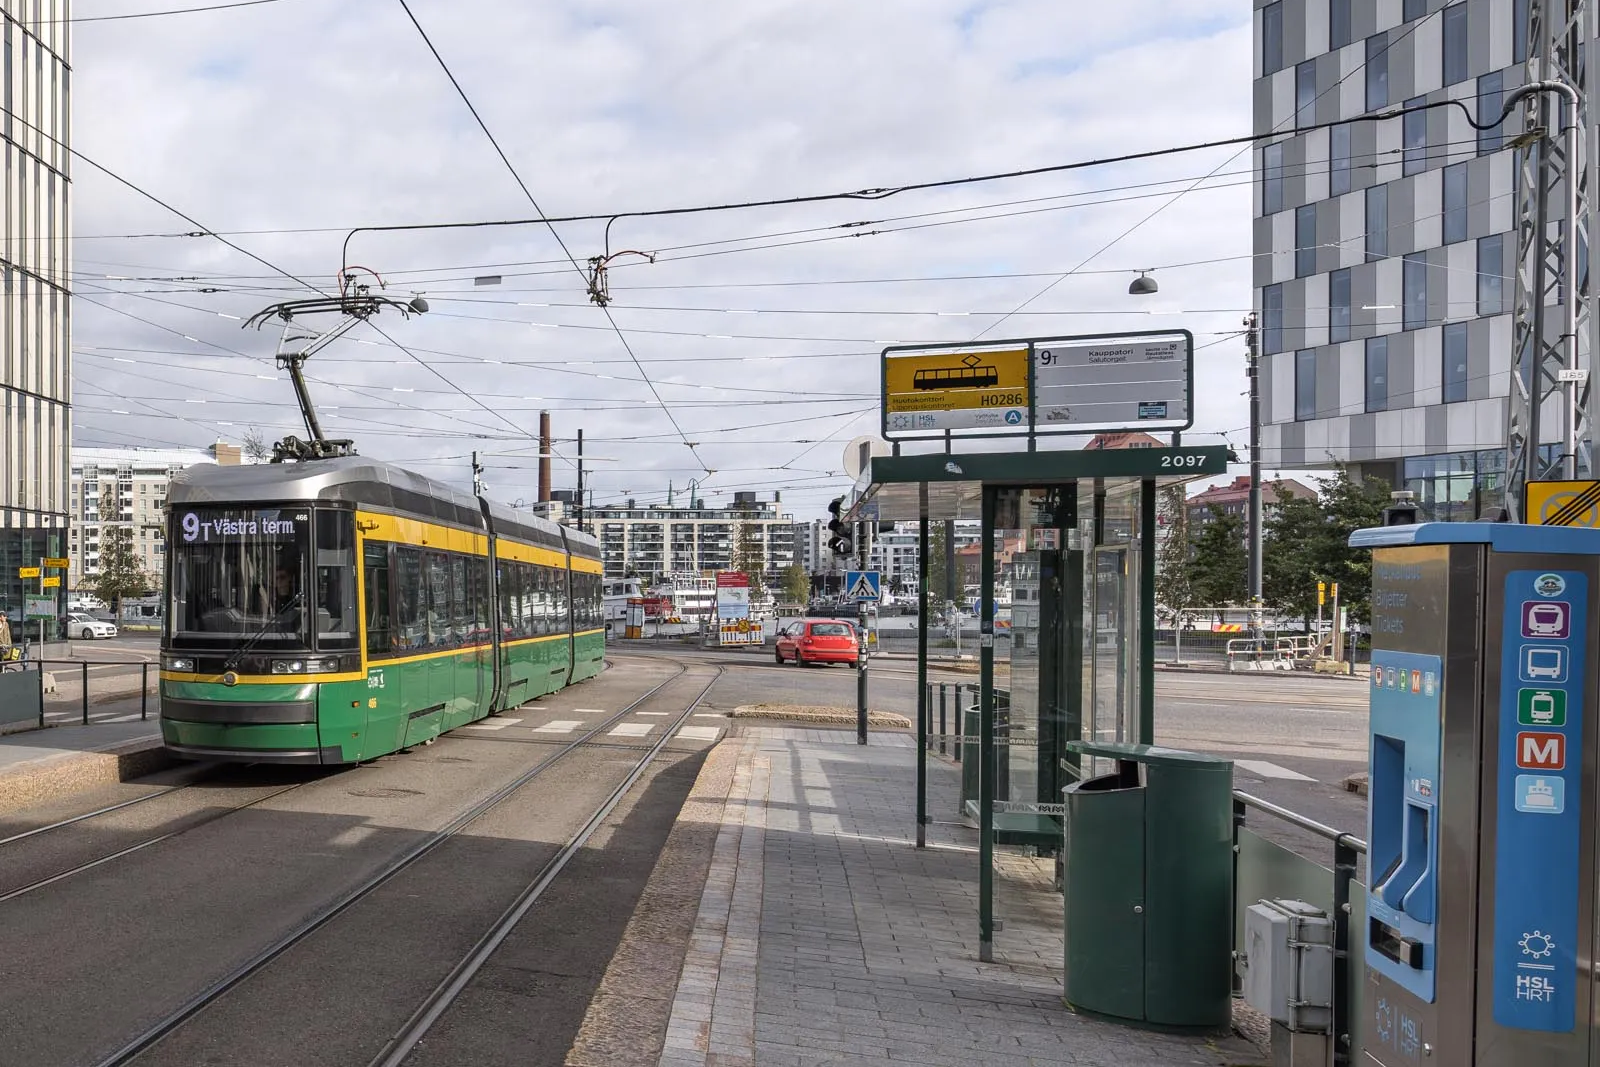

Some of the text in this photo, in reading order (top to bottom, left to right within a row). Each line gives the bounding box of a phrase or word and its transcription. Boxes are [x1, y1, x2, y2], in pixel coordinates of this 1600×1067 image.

[1041, 348, 1134, 365] 9T Kauppatori
[1088, 356, 1127, 365] Salutorget
[893, 393, 1023, 406] Huutokonttori H0286
[1008, 412, 1019, 422] A
[1161, 455, 1207, 467] 2097
[213, 518, 257, 535] Västra
[262, 518, 296, 534] term.
[1377, 588, 1408, 610] Biljetter
[1375, 613, 1404, 634] Tickets
[1412, 674, 1420, 690] M
[1523, 737, 1558, 764] M
[1517, 975, 1555, 989] HSL
[1517, 988, 1555, 1002] HRT
[1401, 1013, 1418, 1042] HSL
